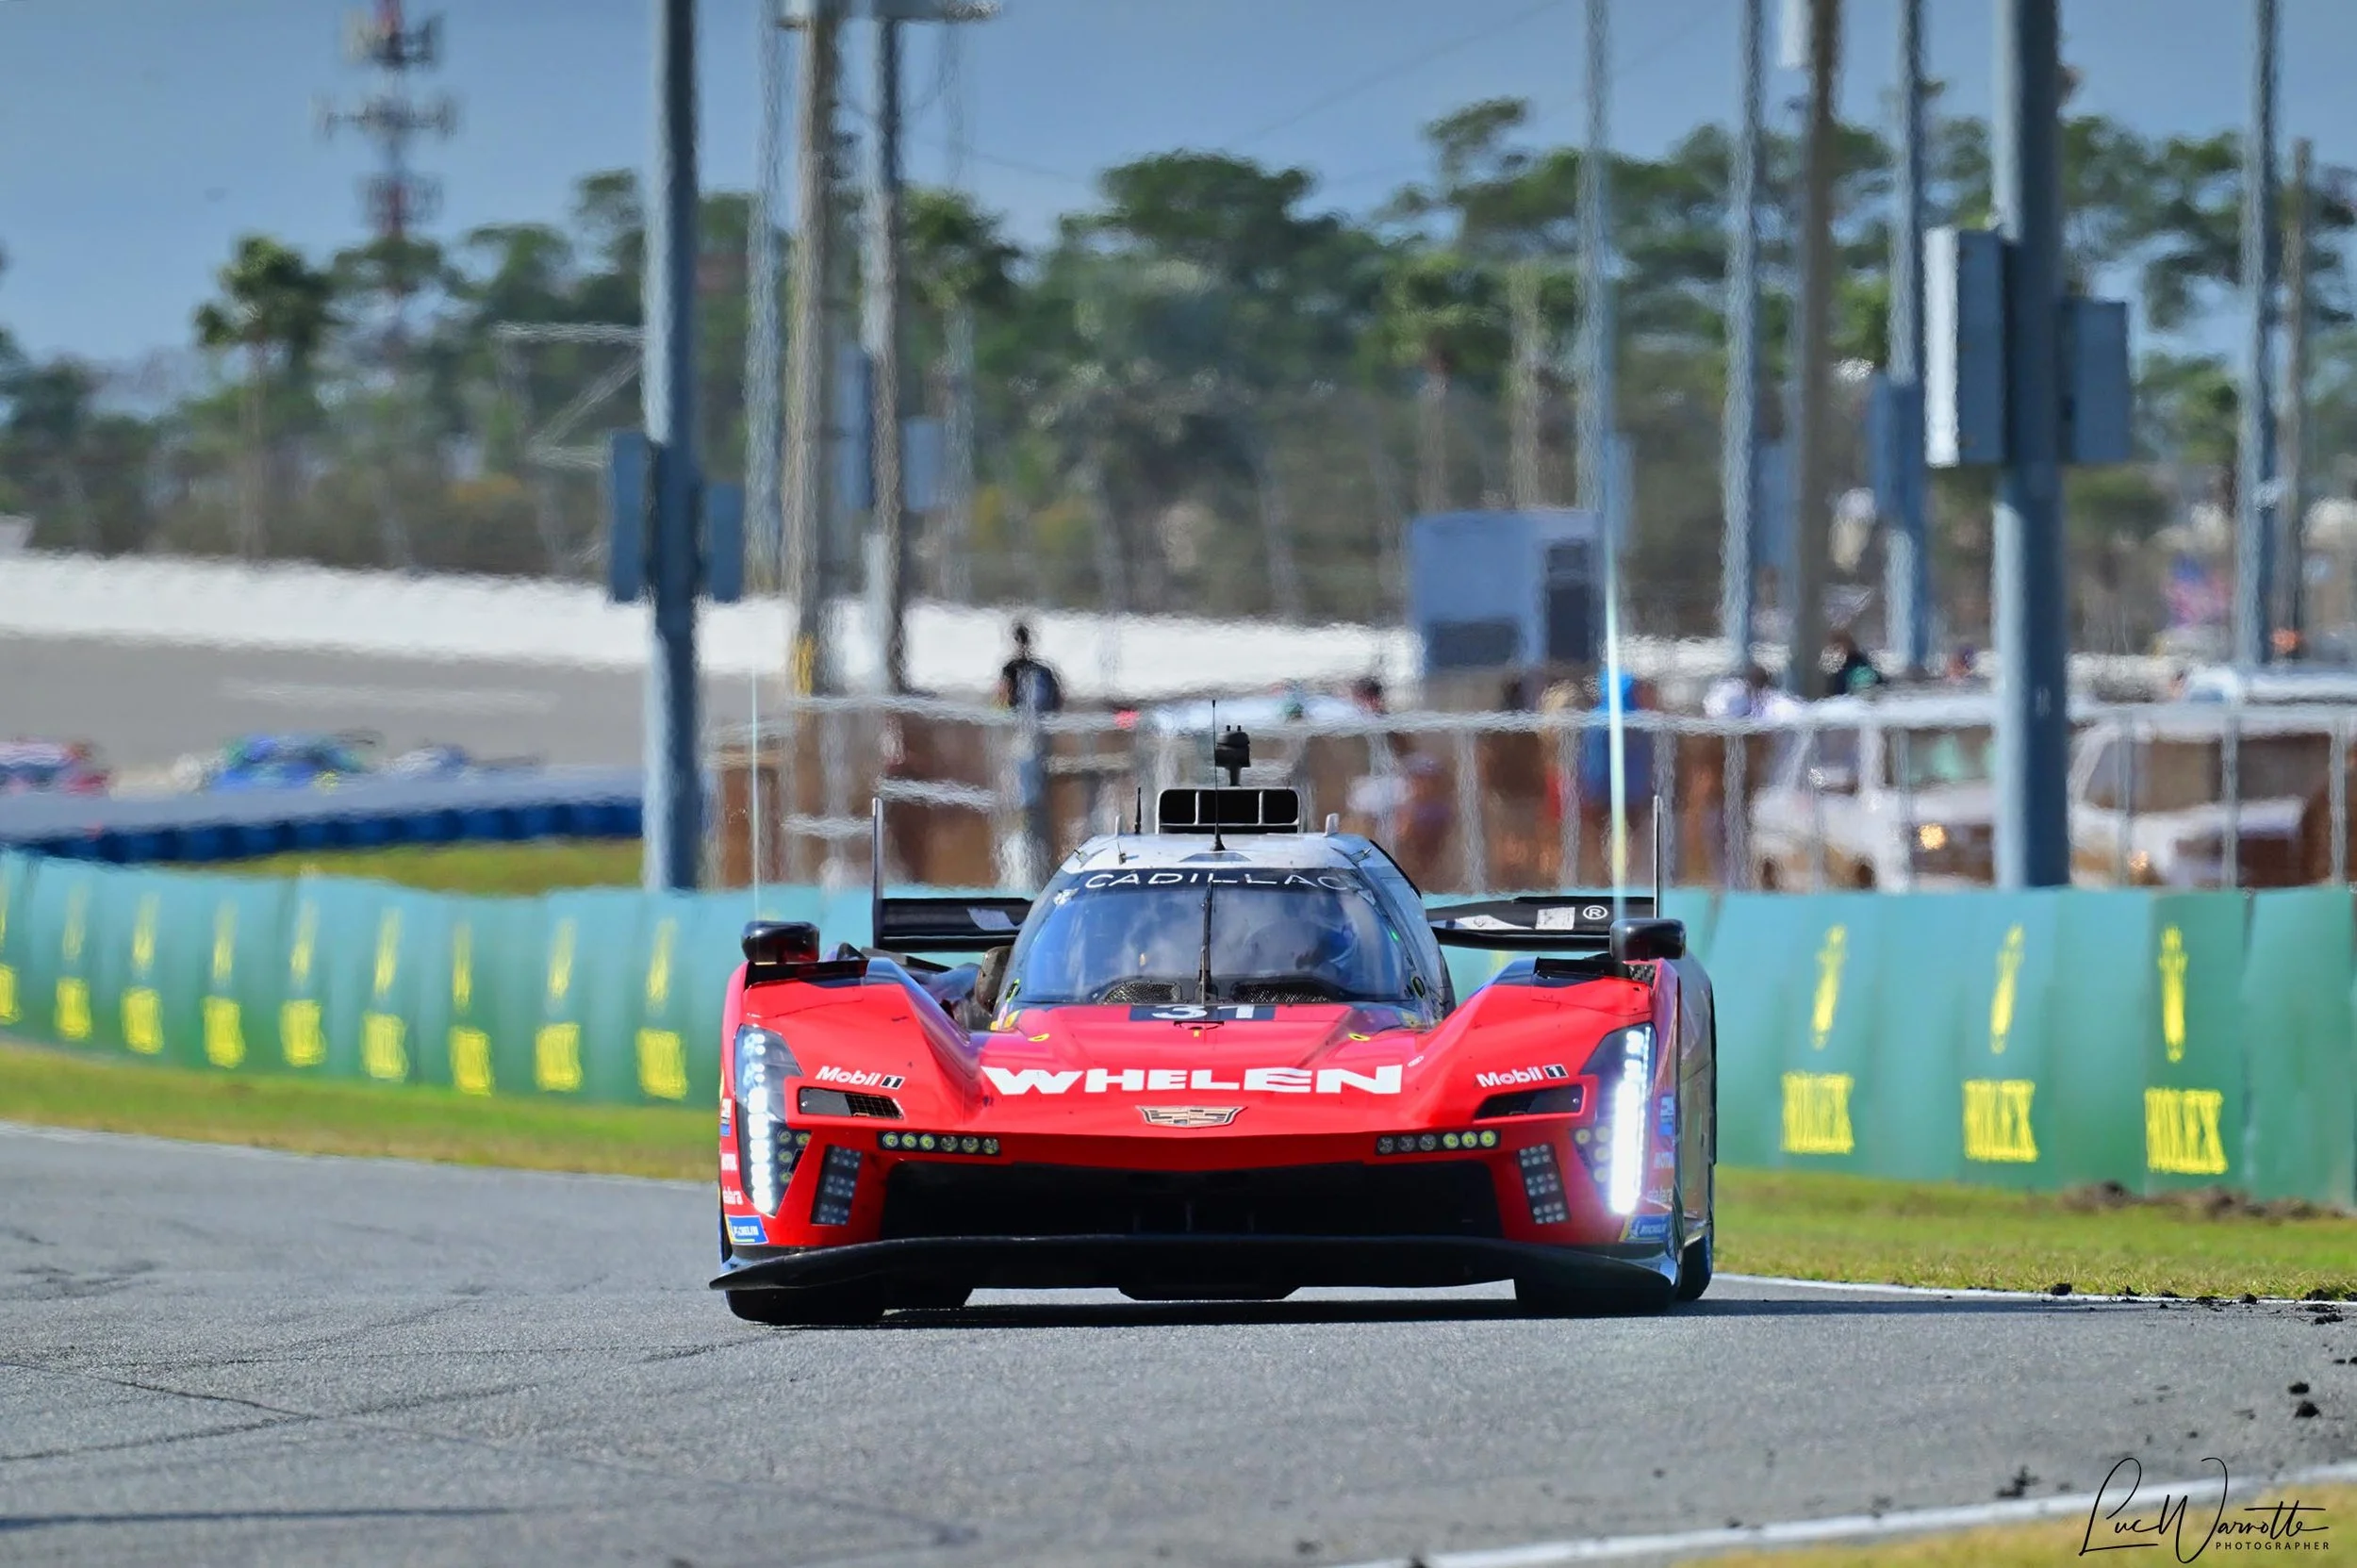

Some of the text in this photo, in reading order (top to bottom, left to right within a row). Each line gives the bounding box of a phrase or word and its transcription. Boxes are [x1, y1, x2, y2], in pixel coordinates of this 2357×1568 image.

[1085, 870, 1348, 889] CADILLAC
[1151, 1005, 1255, 1019] 31
[815, 1065, 882, 1086] Mobil
[981, 1065, 1403, 1096] WHELEN
[1475, 1065, 1543, 1088] Mobil
